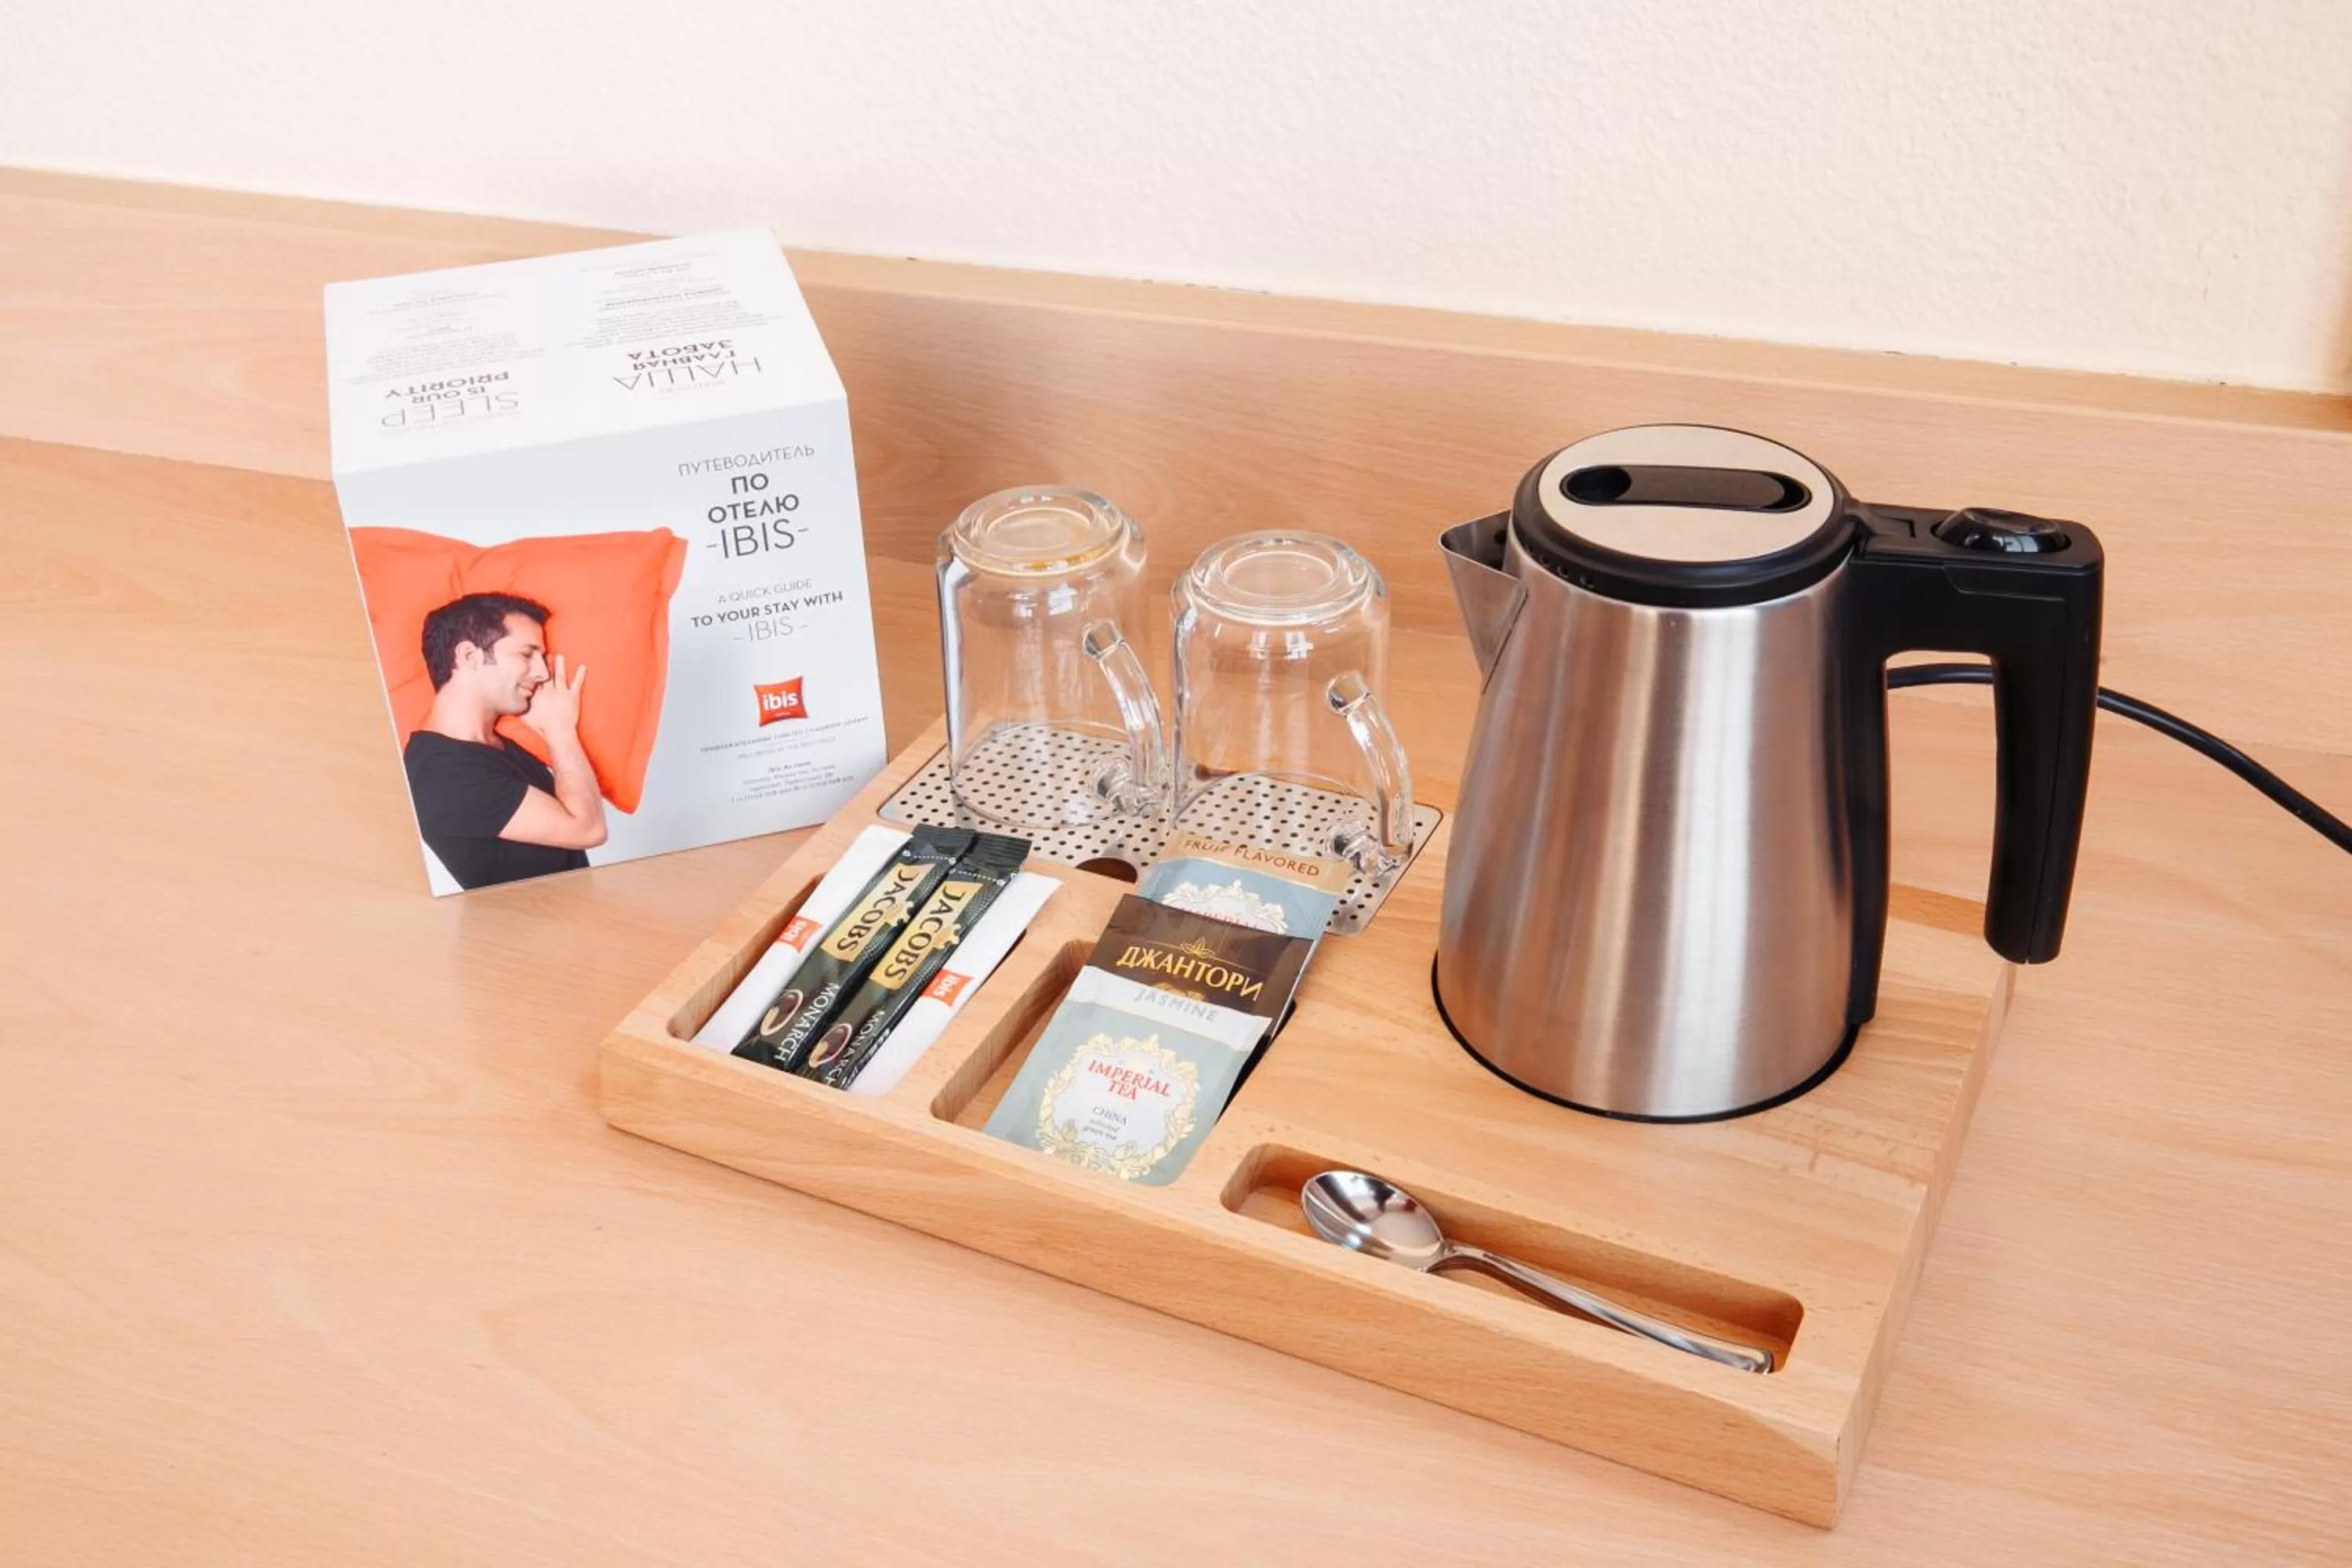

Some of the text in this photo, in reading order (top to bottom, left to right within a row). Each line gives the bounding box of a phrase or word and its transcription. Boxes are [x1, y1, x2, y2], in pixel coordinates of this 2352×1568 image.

[627, 339, 731, 359] ЗАБОТА
[633, 350, 735, 371] ГЛАВНАЯ
[386, 371, 509, 399] PRIORITY
[612, 355, 761, 390] НАША
[382, 391, 518, 426] SLEEP
[412, 385, 485, 404] IS OUR
[678, 444, 815, 477] ПУТЕВОДИТЕЛЬ
[731, 473, 769, 495] ПО
[708, 494, 800, 524] ОТЕЛЮ
[719, 578, 813, 603] A QUICK GUIDE
[691, 590, 844, 628] TO YOUR STAY WITH
[762, 691, 798, 711] ibis
[1184, 838, 1320, 877] FRUIT FLAVORED
[837, 868, 916, 953] JACOBS
[884, 883, 967, 980] JACOBS
[933, 974, 961, 998] ibis
[1115, 945, 1265, 1002] ДЖАНТОРИ
[1131, 989, 1220, 1022] JASMINE
[772, 982, 841, 1063] MONARCH
[1087, 1059, 1171, 1098] IMPERIAL
[1109, 1081, 1137, 1101] TEA
[1092, 1105, 1127, 1127] CHINA
